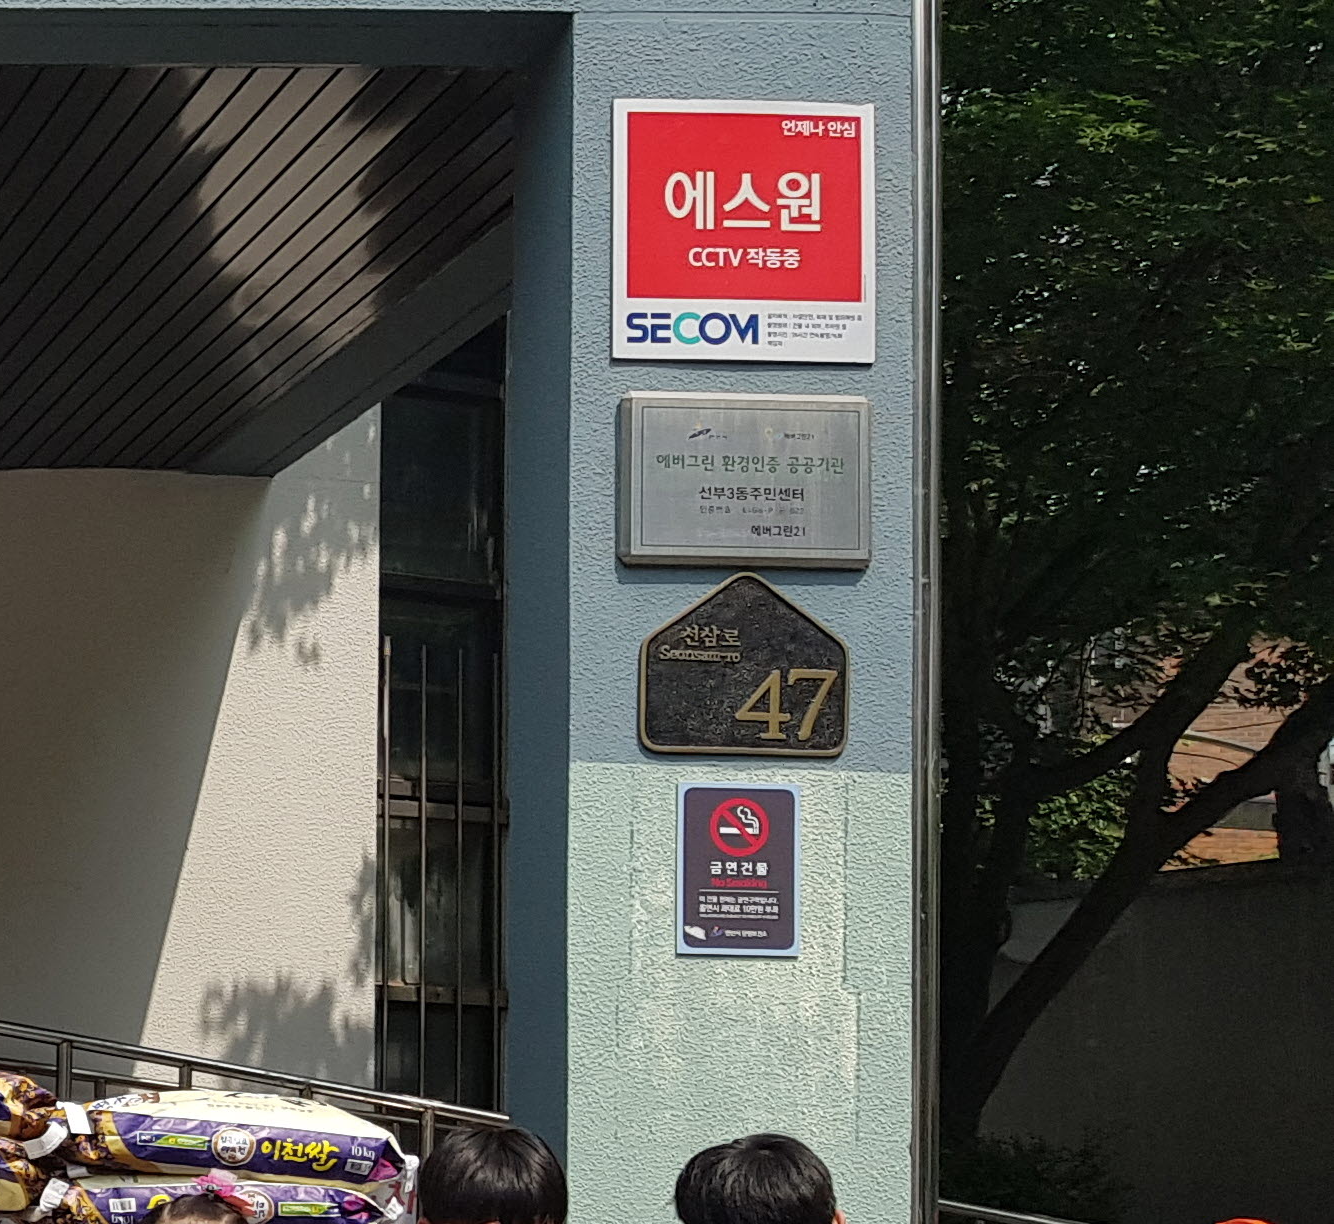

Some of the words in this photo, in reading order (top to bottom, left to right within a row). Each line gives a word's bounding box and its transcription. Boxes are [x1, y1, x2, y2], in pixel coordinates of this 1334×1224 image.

[781, 120, 824, 136] 언제나
[827, 121, 856, 137] 안심
[664, 171, 822, 232] 에스원
[688, 247, 742, 267] CCTV
[746, 248, 800, 268] 작동중
[626, 312, 759, 345] SECOM
[656, 454, 715, 472] 에버그린
[721, 456, 780, 473] 환경인증
[786, 457, 844, 475] 공공기관
[699, 487, 805, 502] 선부3동주민센터
[751, 525, 806, 538] 에버그린21
[681, 624, 741, 646] 선삼로
[659, 645, 741, 663] Seonsam-ro
[735, 668, 838, 741] 47
[710, 862, 768, 875] 금연건물
[261, 1139, 339, 1171] 이천쌀
